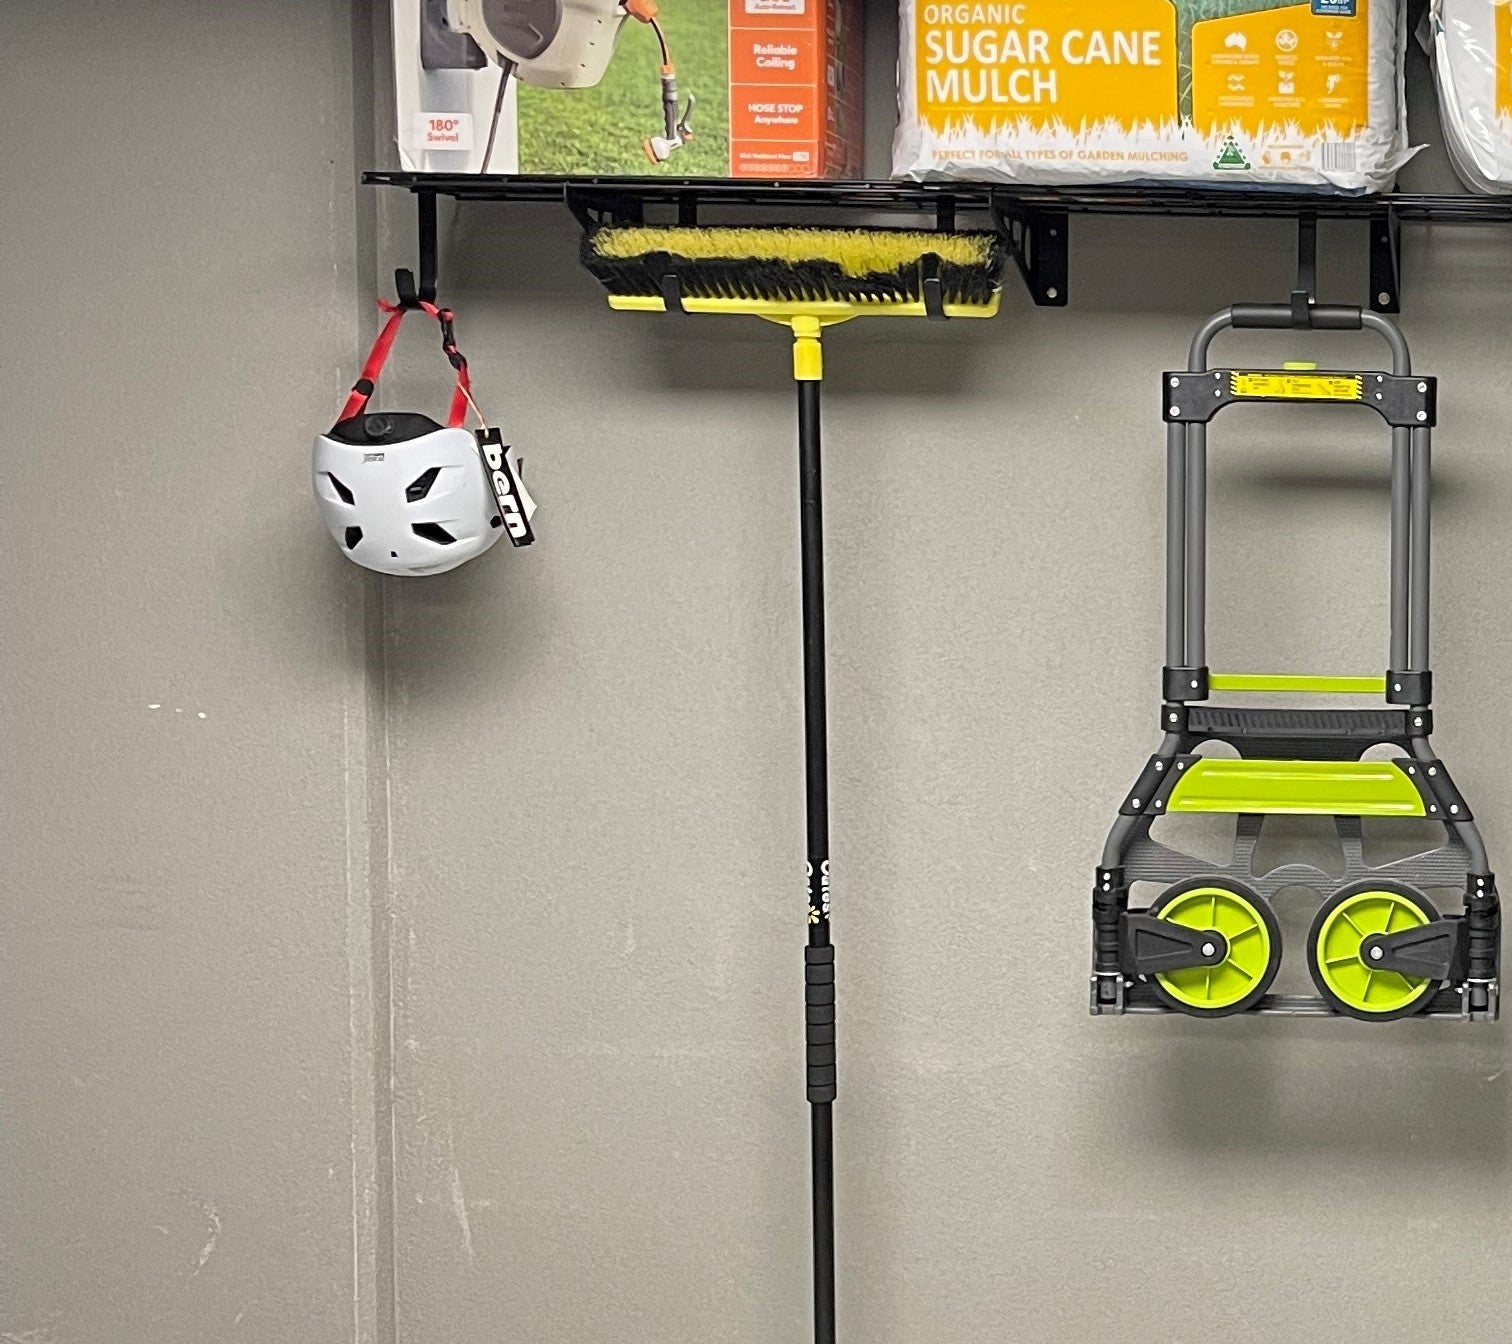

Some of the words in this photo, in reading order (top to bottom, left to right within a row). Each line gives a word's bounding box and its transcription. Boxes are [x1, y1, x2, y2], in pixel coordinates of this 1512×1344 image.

[924, 3, 1026, 25] ORGANIC
[753, 43, 798, 56] Reliable
[925, 28, 1051, 64] SUGAR
[1061, 30, 1162, 66] CANE
[756, 57, 796, 71] Coiling
[926, 68, 1058, 103] MULCH
[748, 103, 775, 114] HOSE
[778, 104, 804, 114] STOP
[430, 119, 459, 131] 180°
[427, 132, 459, 142] Swivel
[931, 149, 975, 161] PERFECT
[979, 149, 1002, 161] FOR
[1004, 149, 1022, 161] ALL
[1025, 149, 1056, 161] TYPES
[1059, 149, 1074, 161] OF
[1078, 149, 1124, 161] GARDEN
[1127, 149, 1188, 161] MULCHING
